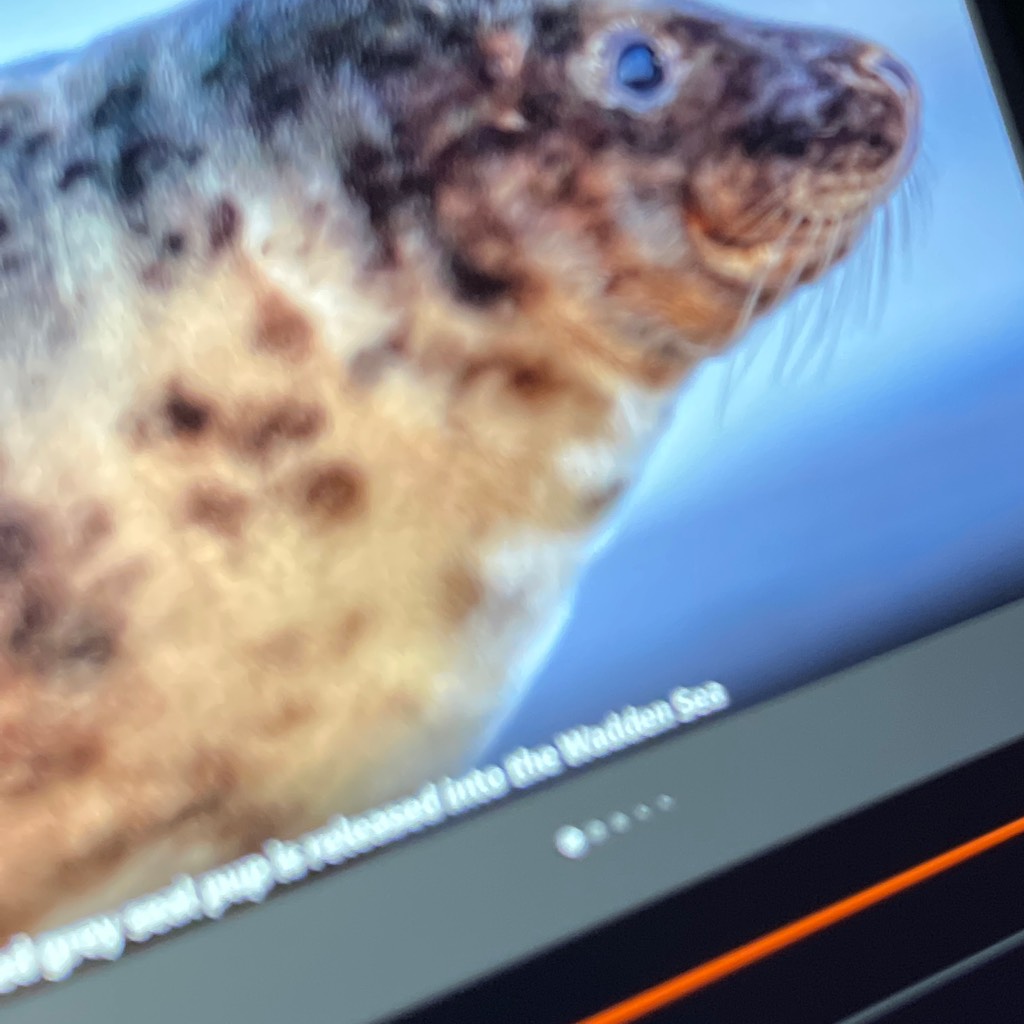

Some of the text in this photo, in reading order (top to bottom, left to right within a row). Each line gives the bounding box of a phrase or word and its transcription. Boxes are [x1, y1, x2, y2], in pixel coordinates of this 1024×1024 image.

[41, 913, 126, 982] grey
[123, 873, 201, 942] seal
[199, 853, 276, 919] pup
[263, 838, 308, 884] is
[304, 782, 446, 871] released
[441, 764, 510, 816] into
[503, 744, 564, 788] the
[554, 700, 678, 767] Wadden
[669, 681, 729, 723] Sea
